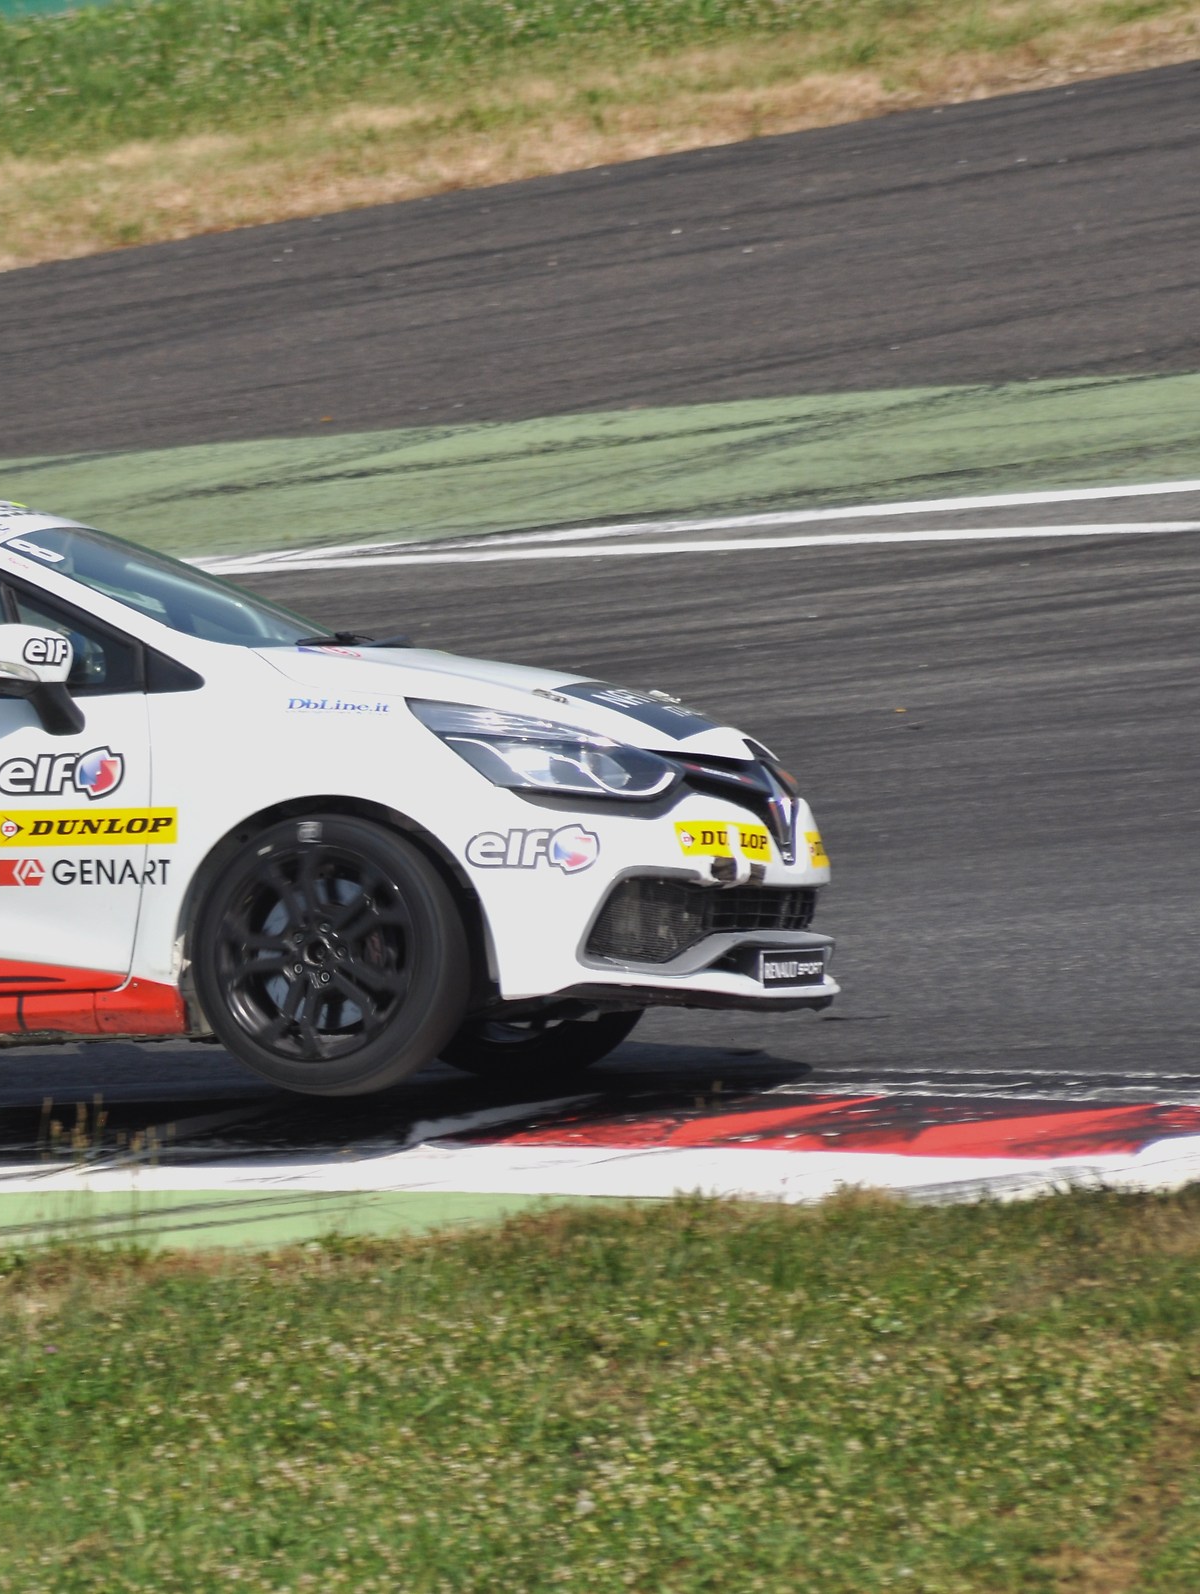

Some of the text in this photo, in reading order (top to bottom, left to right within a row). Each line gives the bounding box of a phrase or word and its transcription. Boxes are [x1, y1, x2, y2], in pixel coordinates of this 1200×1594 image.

[23, 637, 69, 666] elf
[288, 698, 390, 713] DbLine.it
[28, 817, 173, 836] DUNLOP
[465, 828, 554, 869] elf
[701, 830, 769, 850] DULOP
[52, 859, 171, 885] GENART
